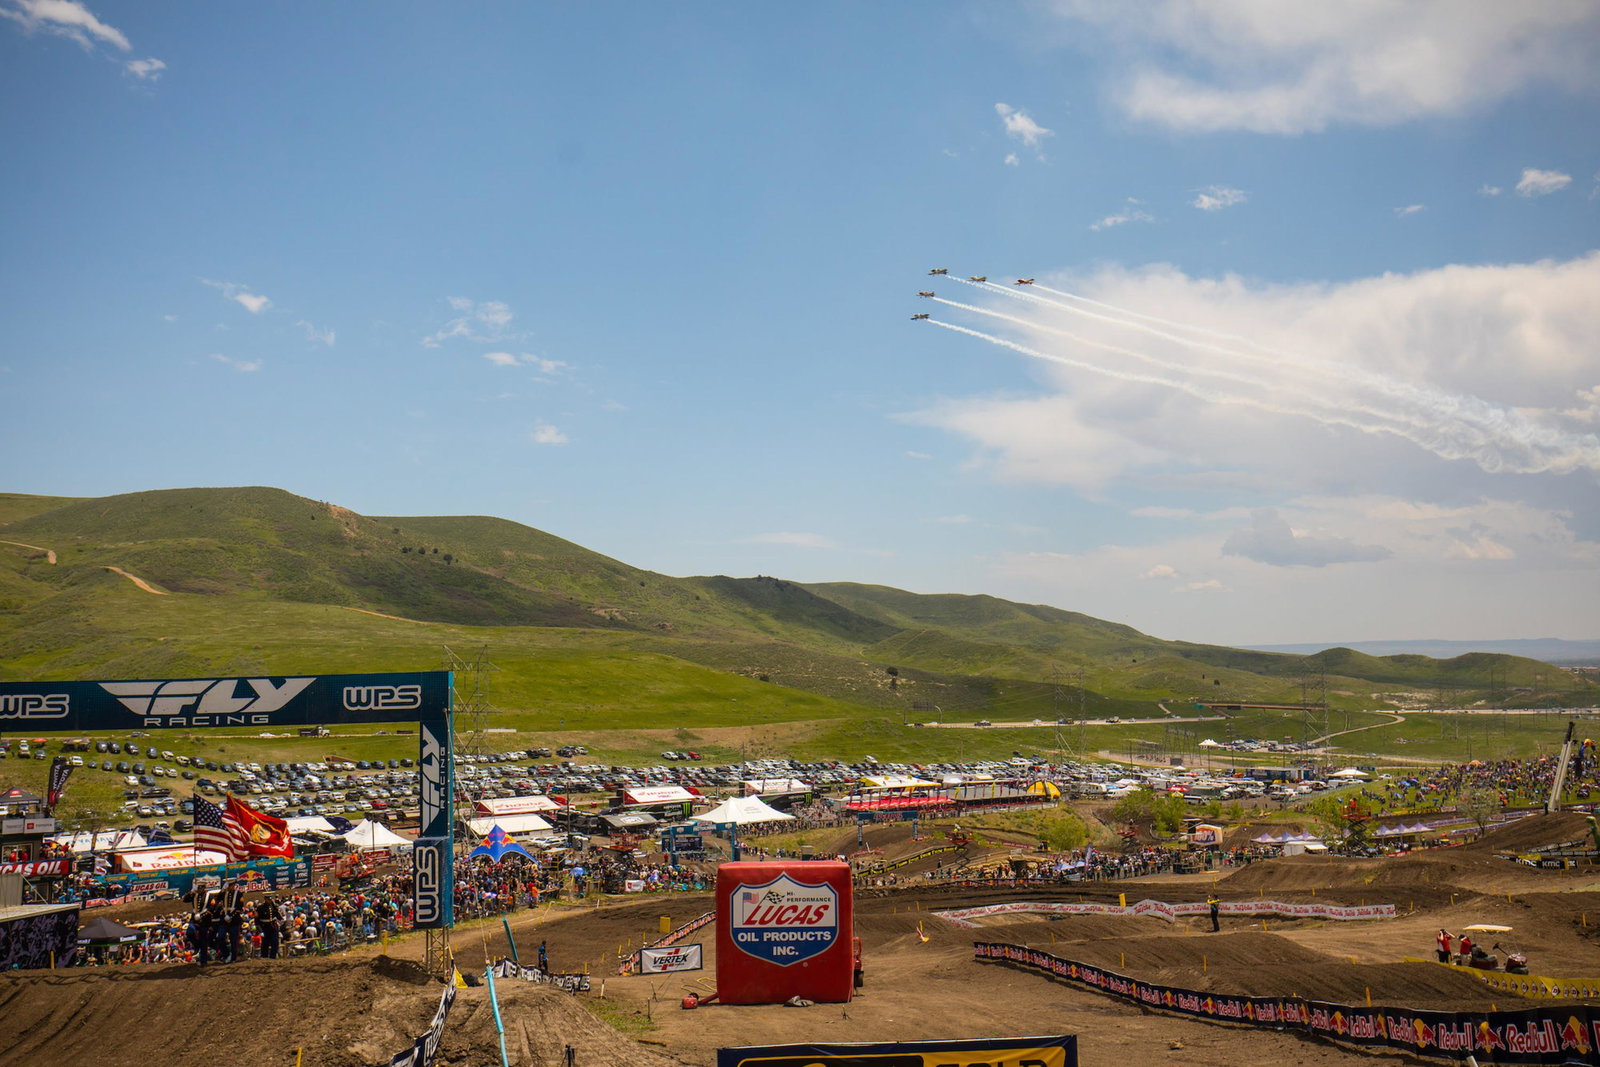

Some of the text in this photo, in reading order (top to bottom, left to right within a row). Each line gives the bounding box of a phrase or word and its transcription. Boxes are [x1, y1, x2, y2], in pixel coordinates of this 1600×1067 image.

[98, 677, 318, 715] FLY
[343, 685, 422, 711] WPS
[0, 694, 70, 719] WPS
[143, 714, 270, 727] RACING
[0, 860, 62, 877] CAS OIL
[416, 846, 439, 923] WPS
[742, 904, 830, 926] LUCAS
[737, 931, 832, 942] OIL PRODUCTS
[653, 954, 689, 965] VERTEX
[772, 946, 800, 956] INC.
